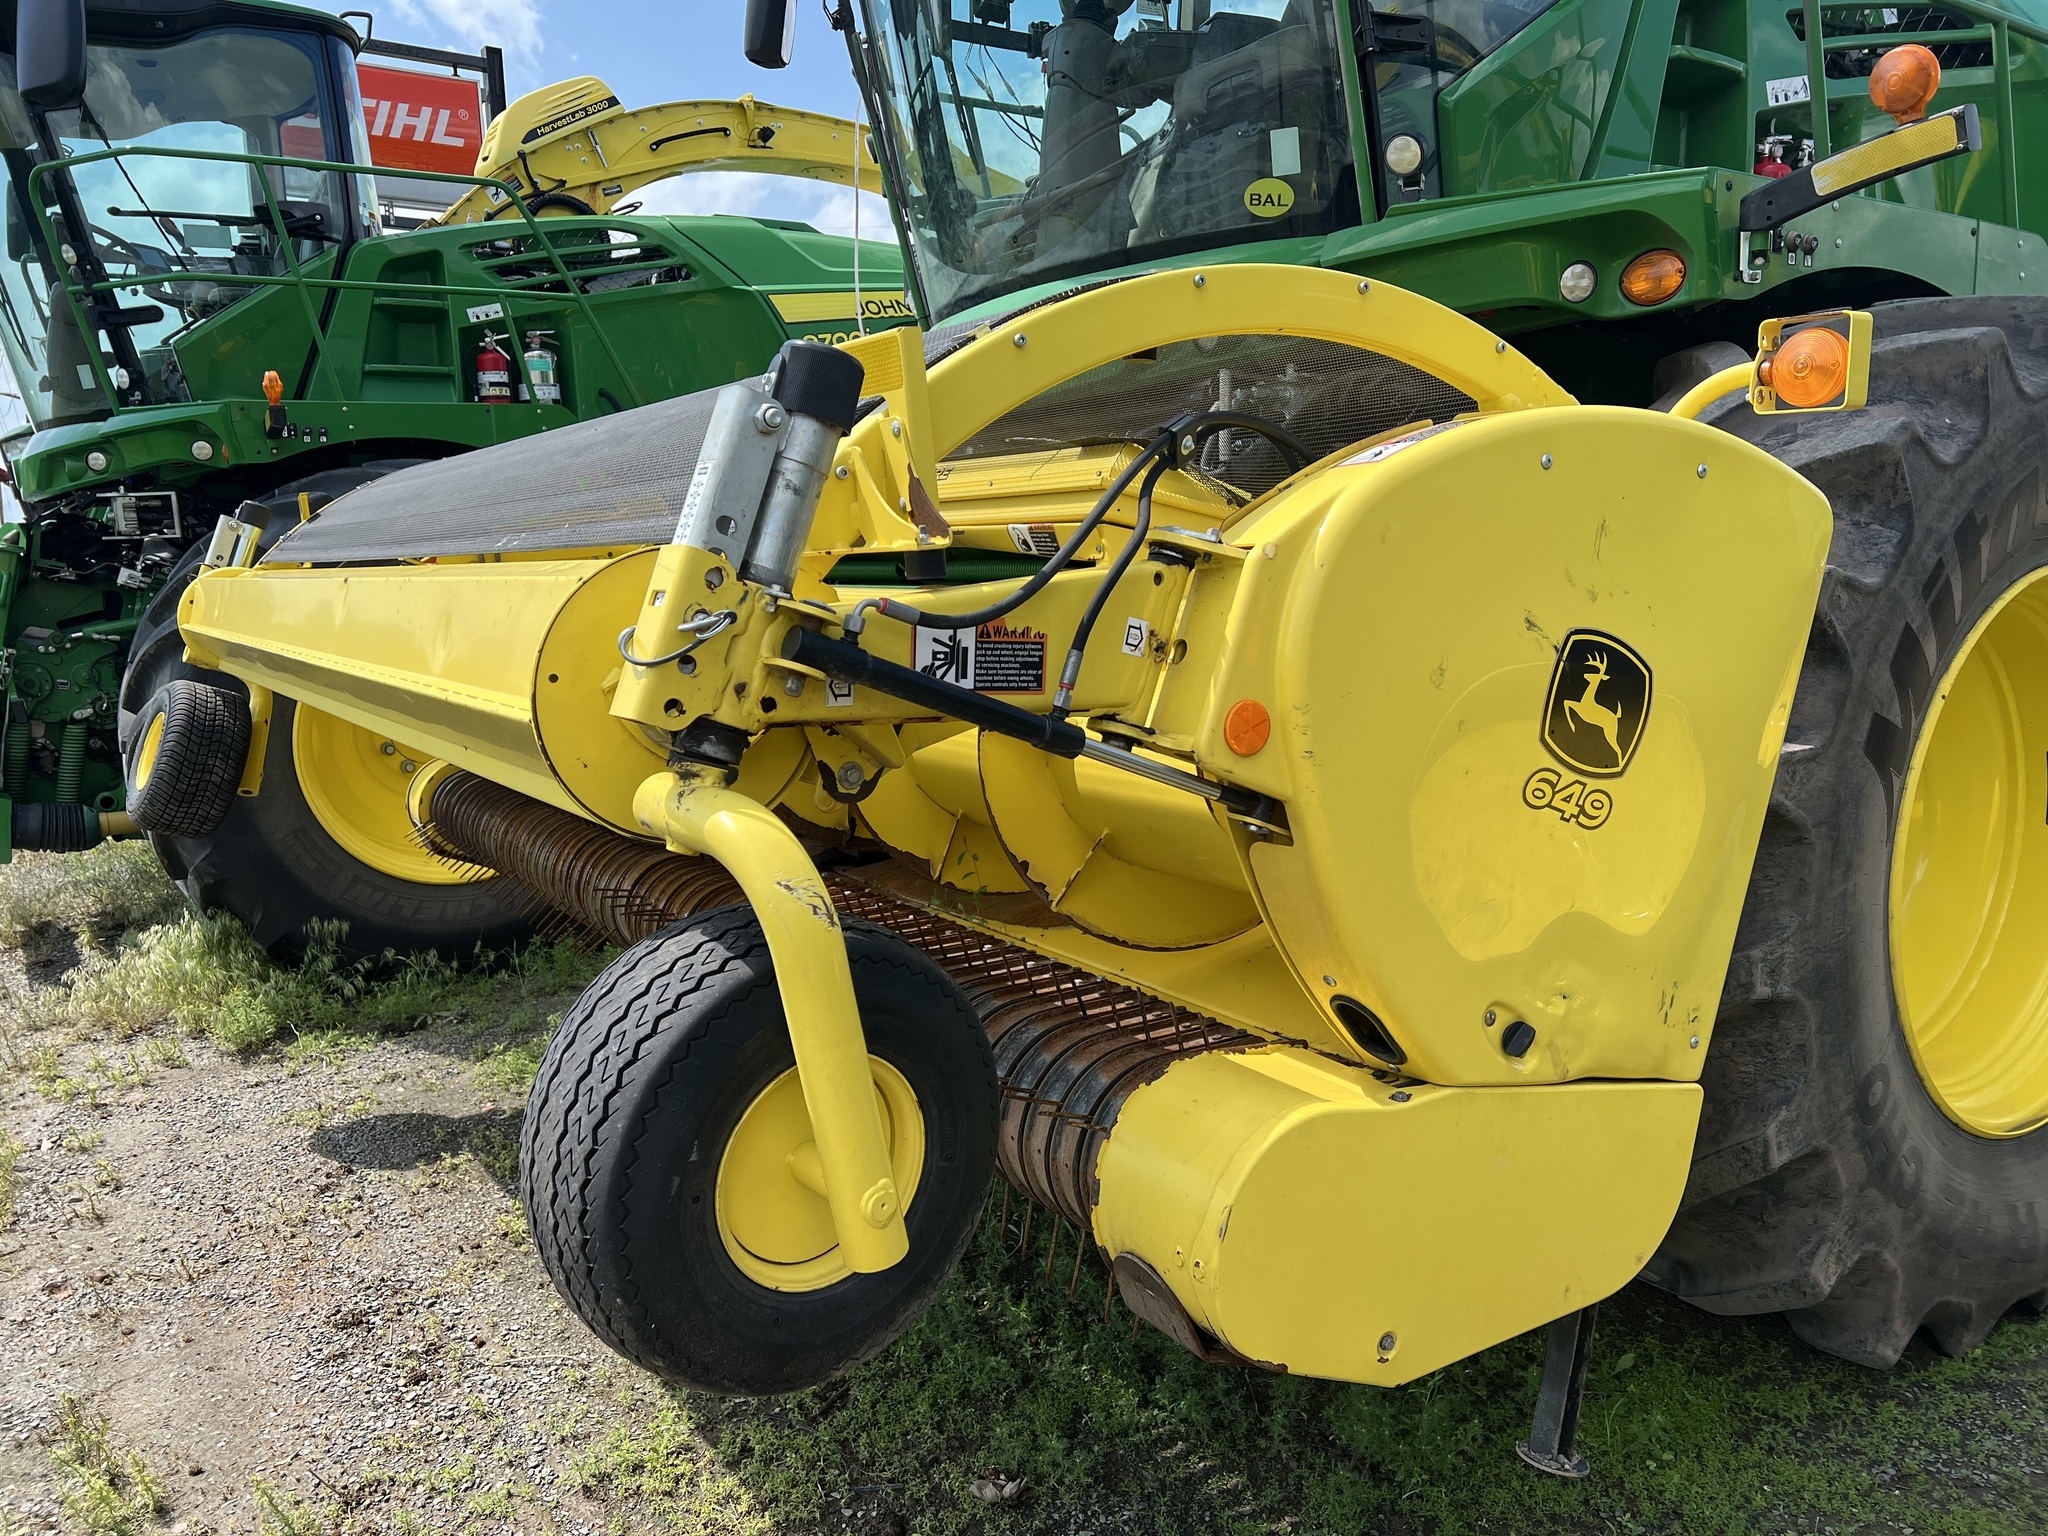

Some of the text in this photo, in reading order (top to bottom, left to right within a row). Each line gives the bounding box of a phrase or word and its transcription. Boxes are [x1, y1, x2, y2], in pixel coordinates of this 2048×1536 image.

[536, 100, 609, 136] HarvestLab 3000
[1249, 193, 1289, 207] BAL
[855, 299, 913, 316] JOHN
[1522, 766, 1613, 830] 649
